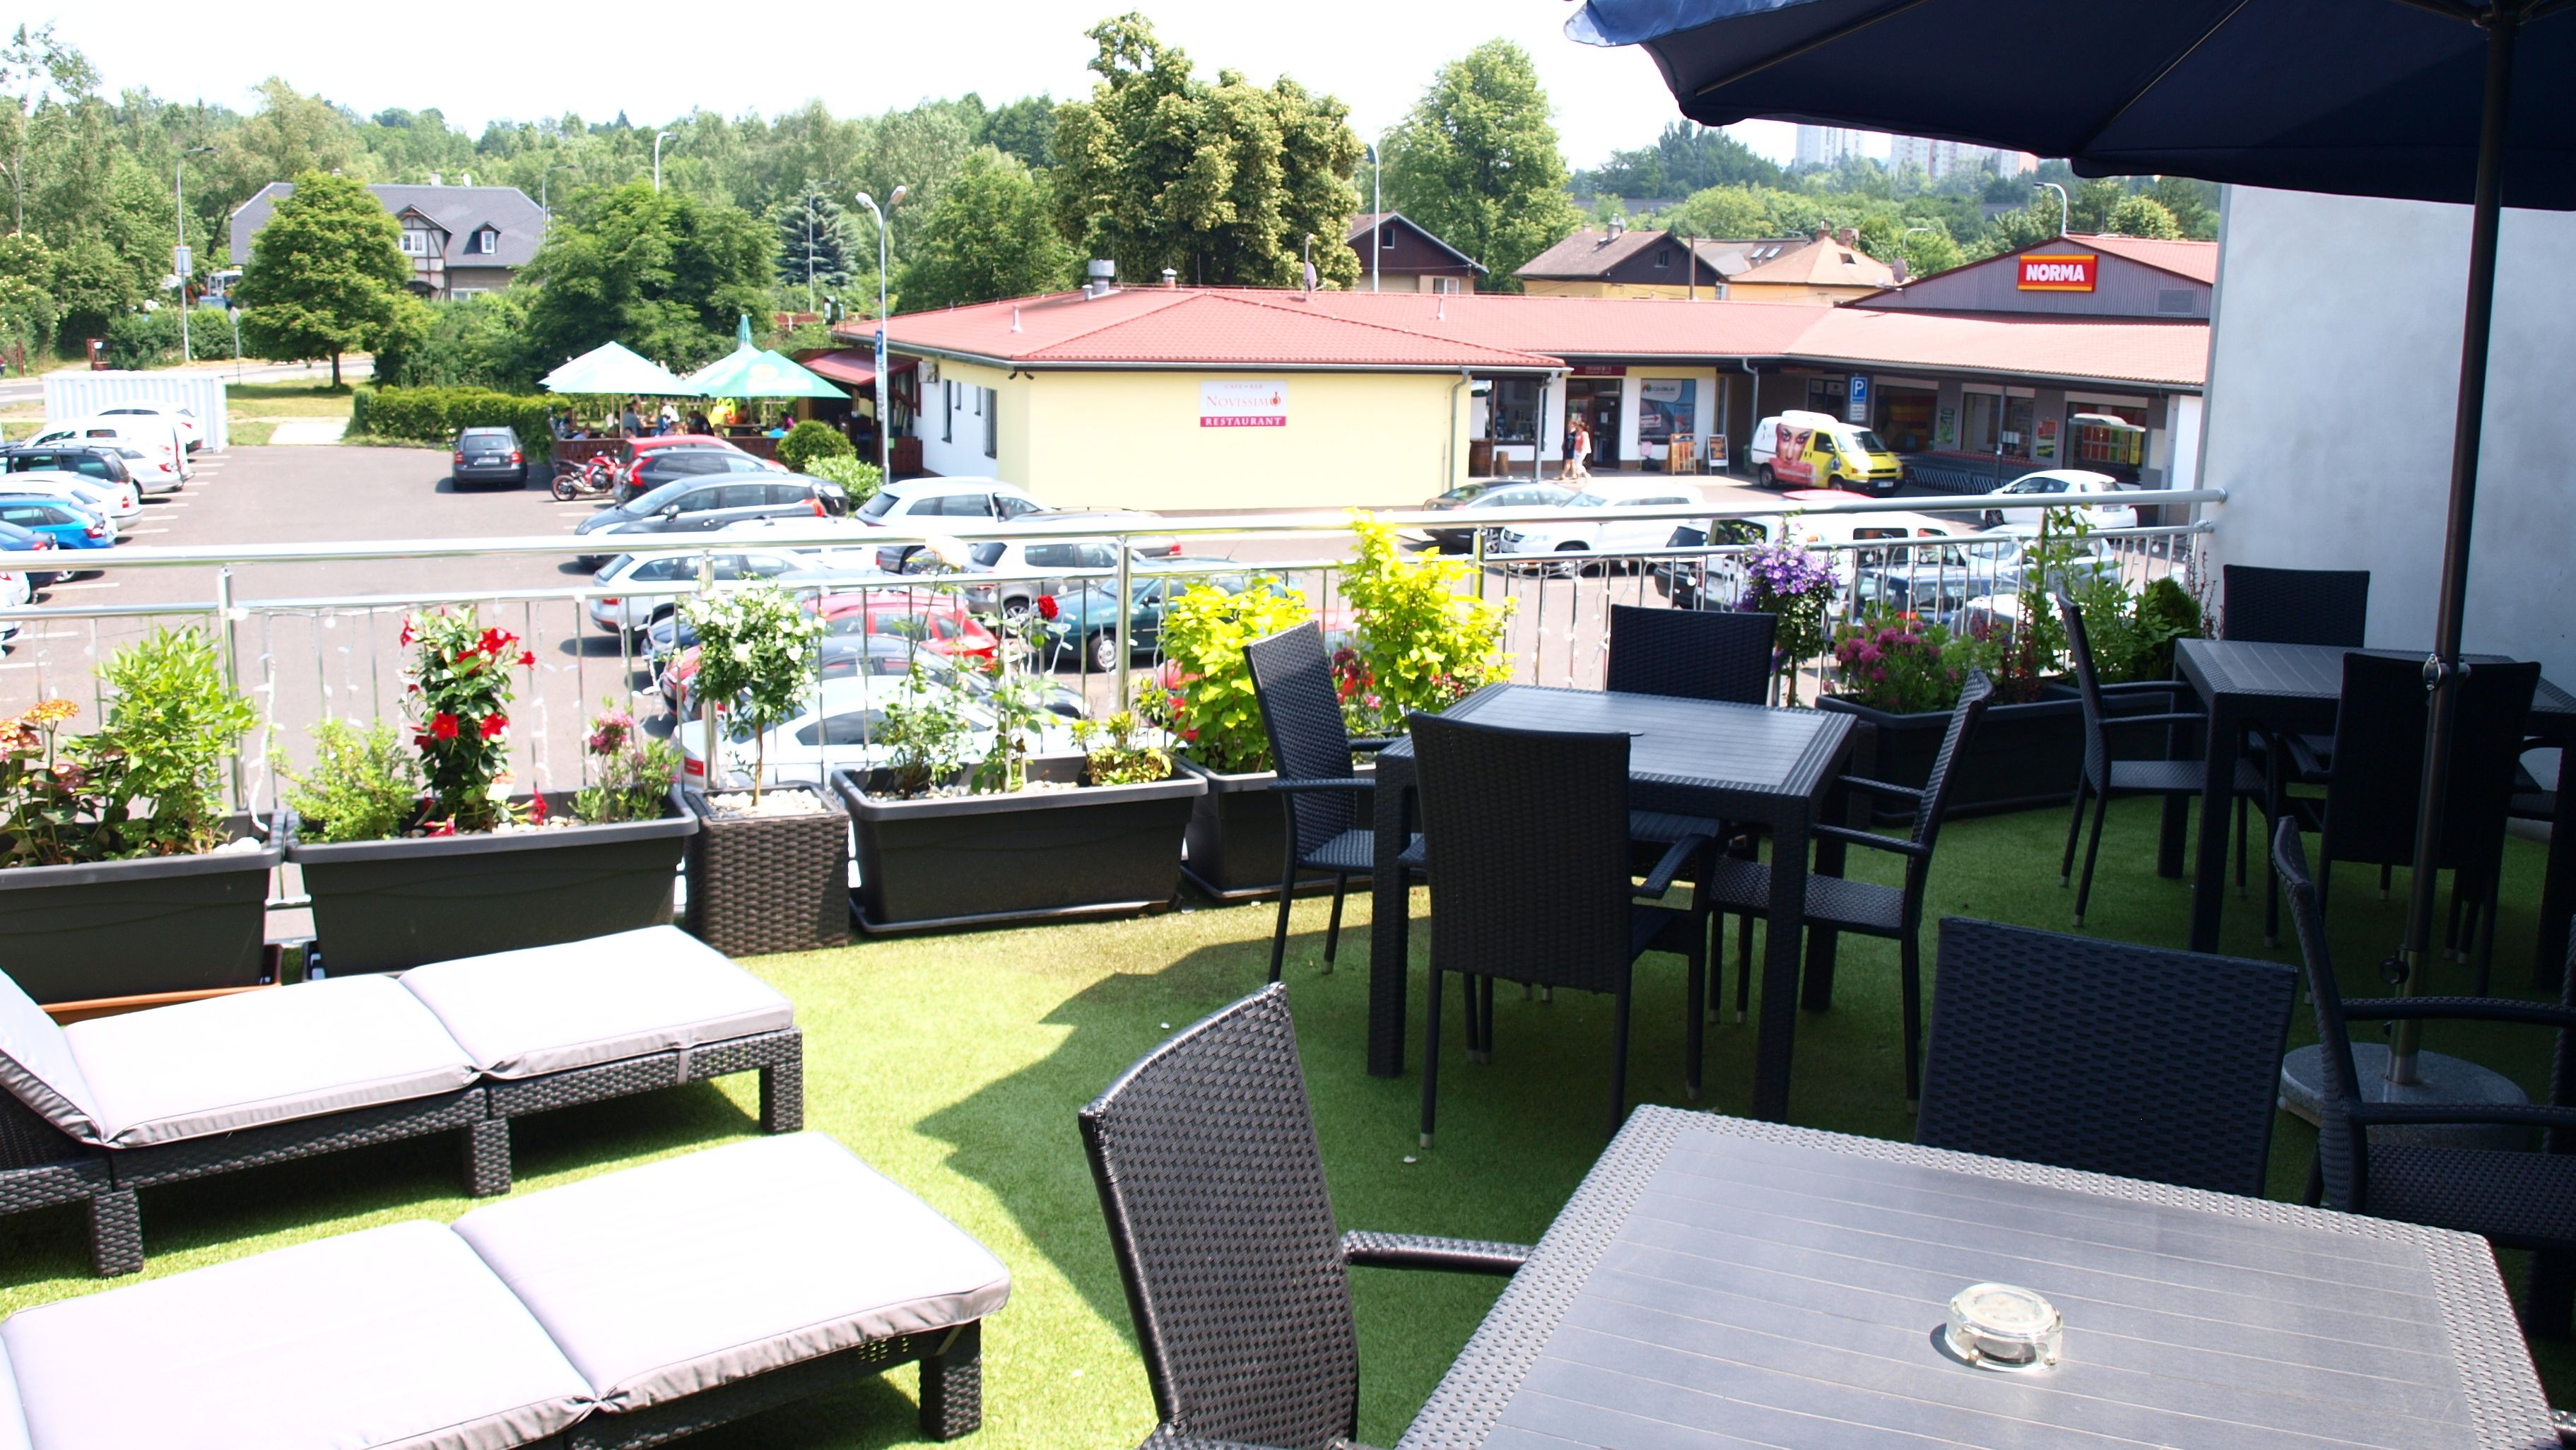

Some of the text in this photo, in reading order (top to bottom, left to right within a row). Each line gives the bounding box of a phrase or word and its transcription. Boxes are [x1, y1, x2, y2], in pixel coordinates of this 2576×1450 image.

[2025, 264, 2085, 282] NORMA
[1854, 380, 1864, 396] P
[1205, 417, 1281, 426] RESTAURANT
